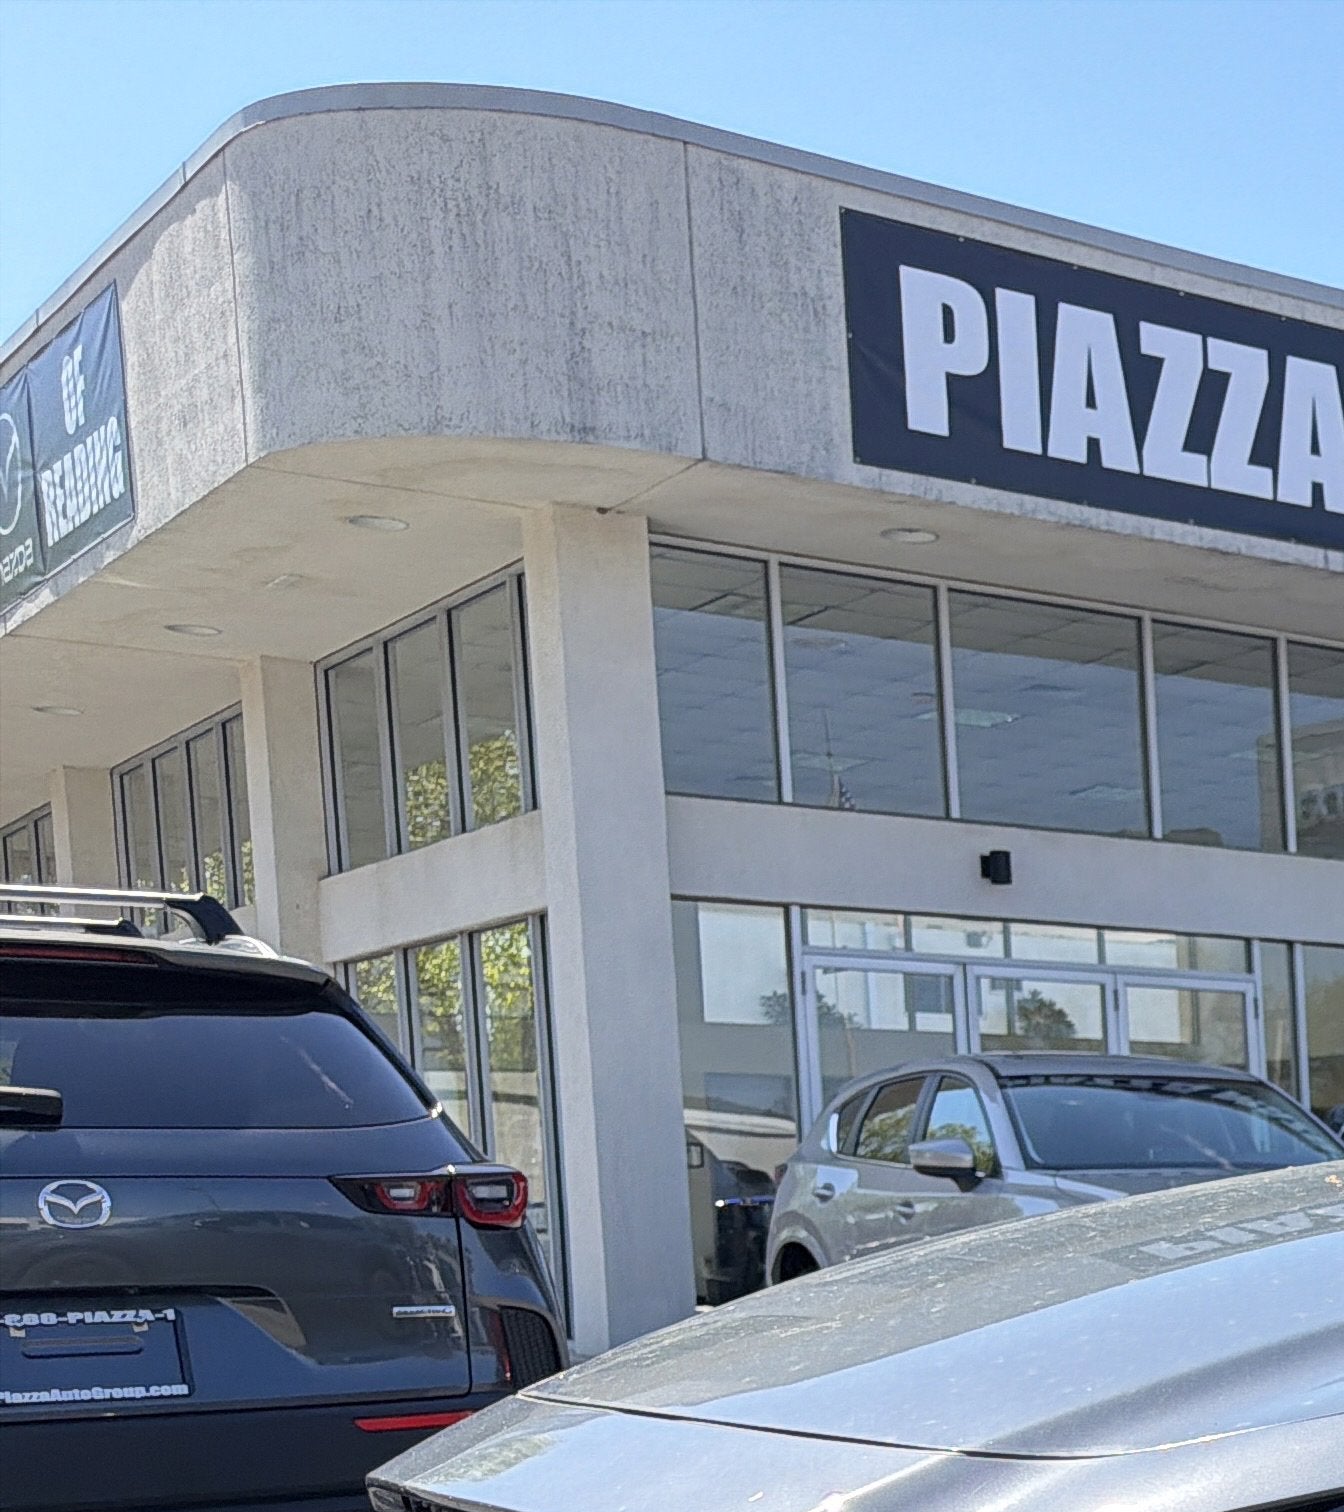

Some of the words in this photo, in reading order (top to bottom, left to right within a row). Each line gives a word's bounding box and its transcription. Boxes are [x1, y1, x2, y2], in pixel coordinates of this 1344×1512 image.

[61, 344, 86, 436] OF
[41, 415, 126, 548] READING
[0, 537, 34, 588] azda
